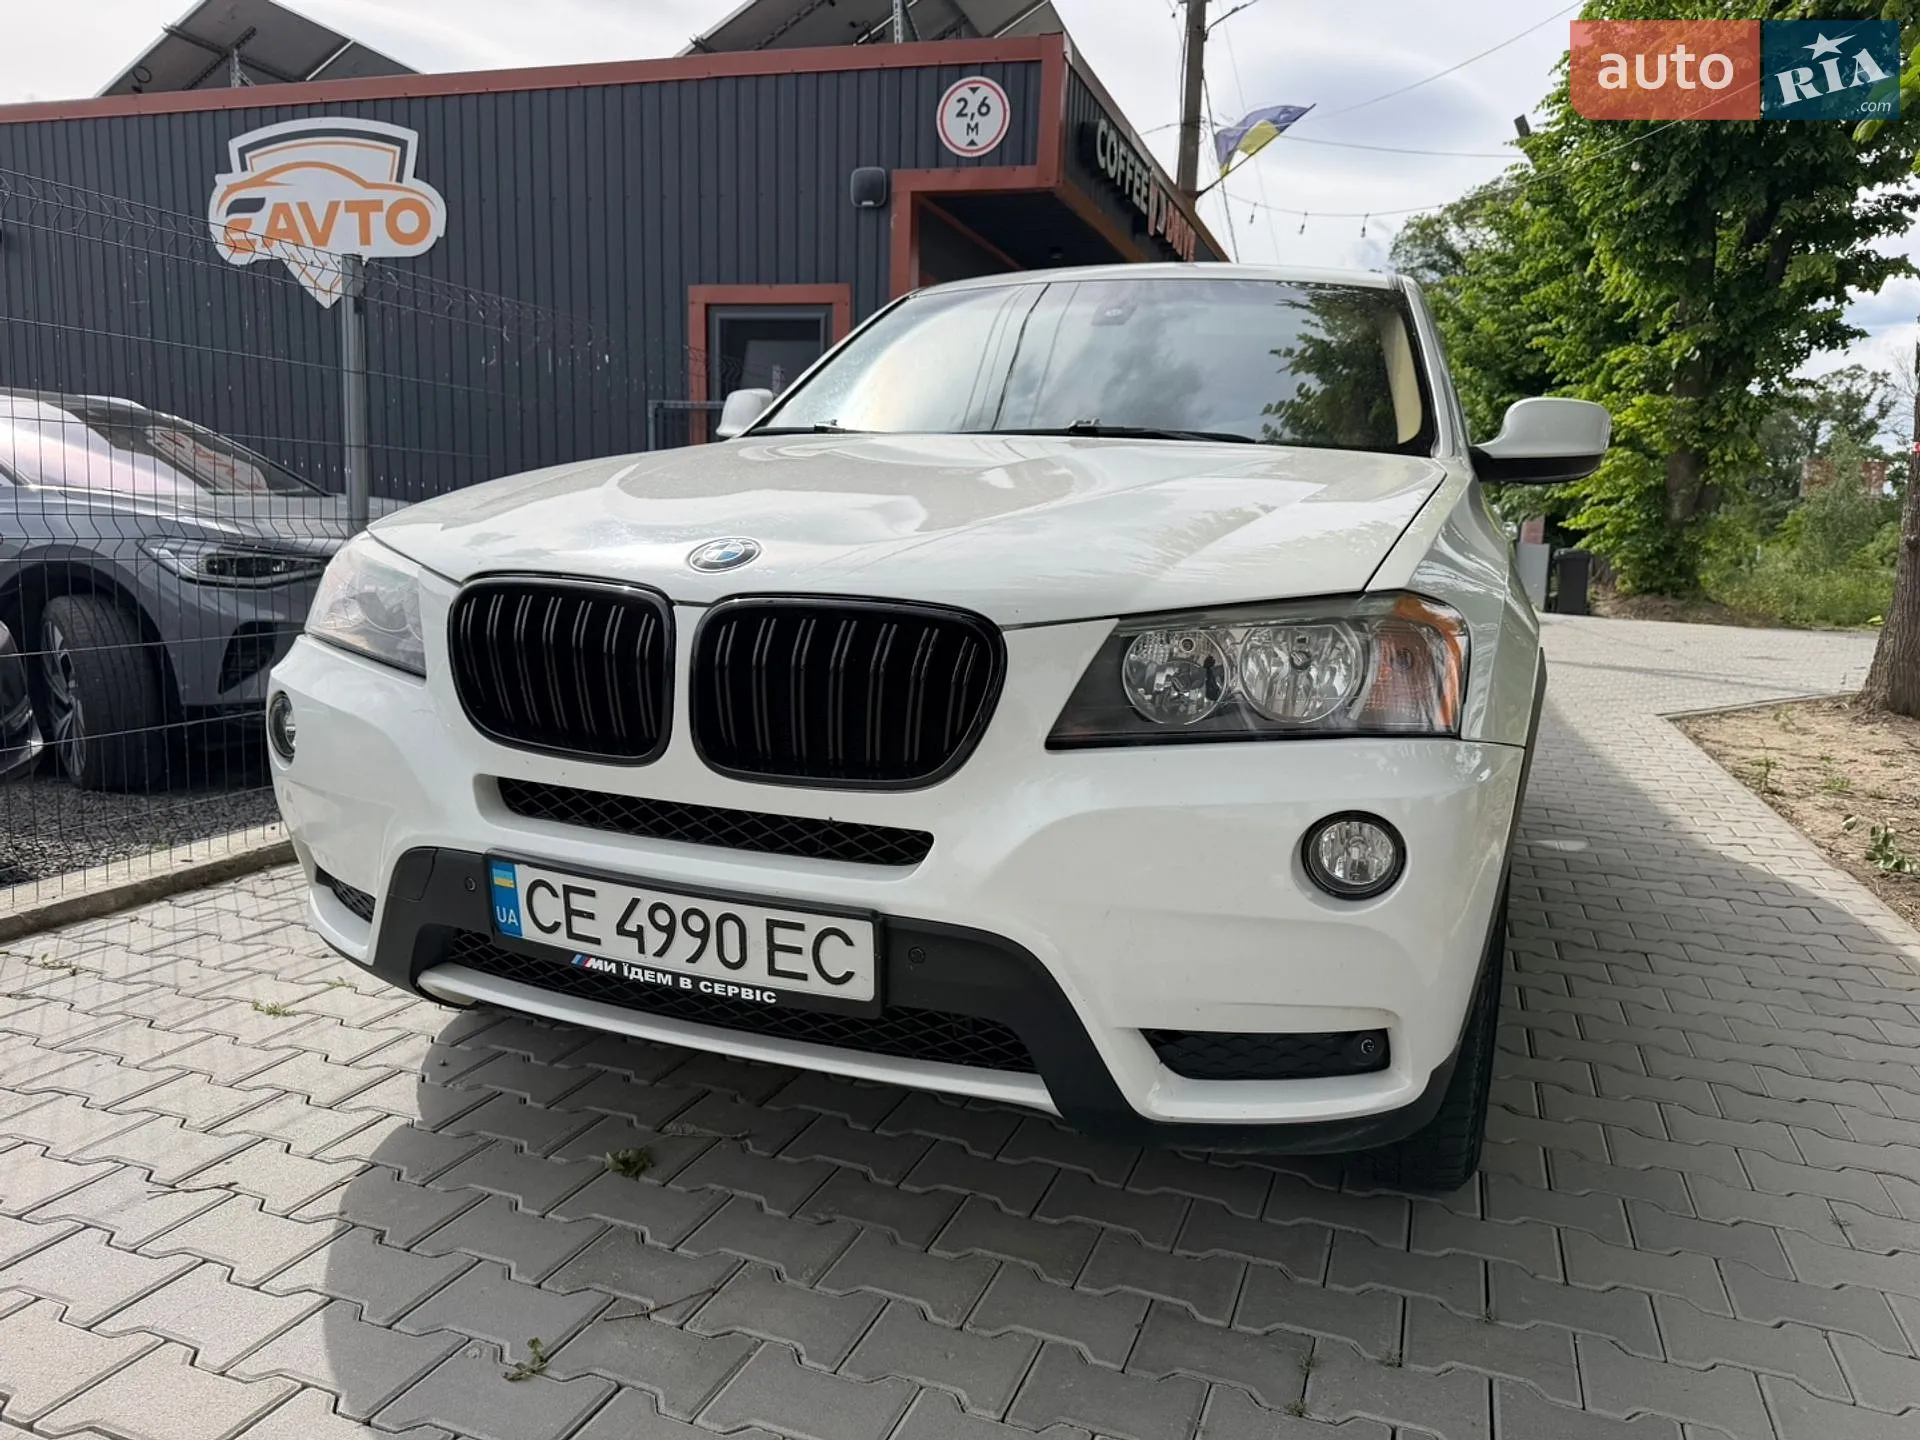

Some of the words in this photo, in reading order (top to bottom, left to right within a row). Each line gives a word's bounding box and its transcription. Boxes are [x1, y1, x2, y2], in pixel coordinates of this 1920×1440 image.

[955, 96, 991, 121] 2,6
[1096, 118, 1149, 216] COFFEE
[496, 905, 520, 925] UA
[525, 878, 601, 946] CE
[615, 897, 748, 971] 4990
[765, 918, 856, 986] EC
[588, 957, 617, 974] МИ
[622, 961, 673, 987] ЇДЕМ
[679, 976, 693, 990] В
[700, 981, 777, 1004] СЕРВІС
